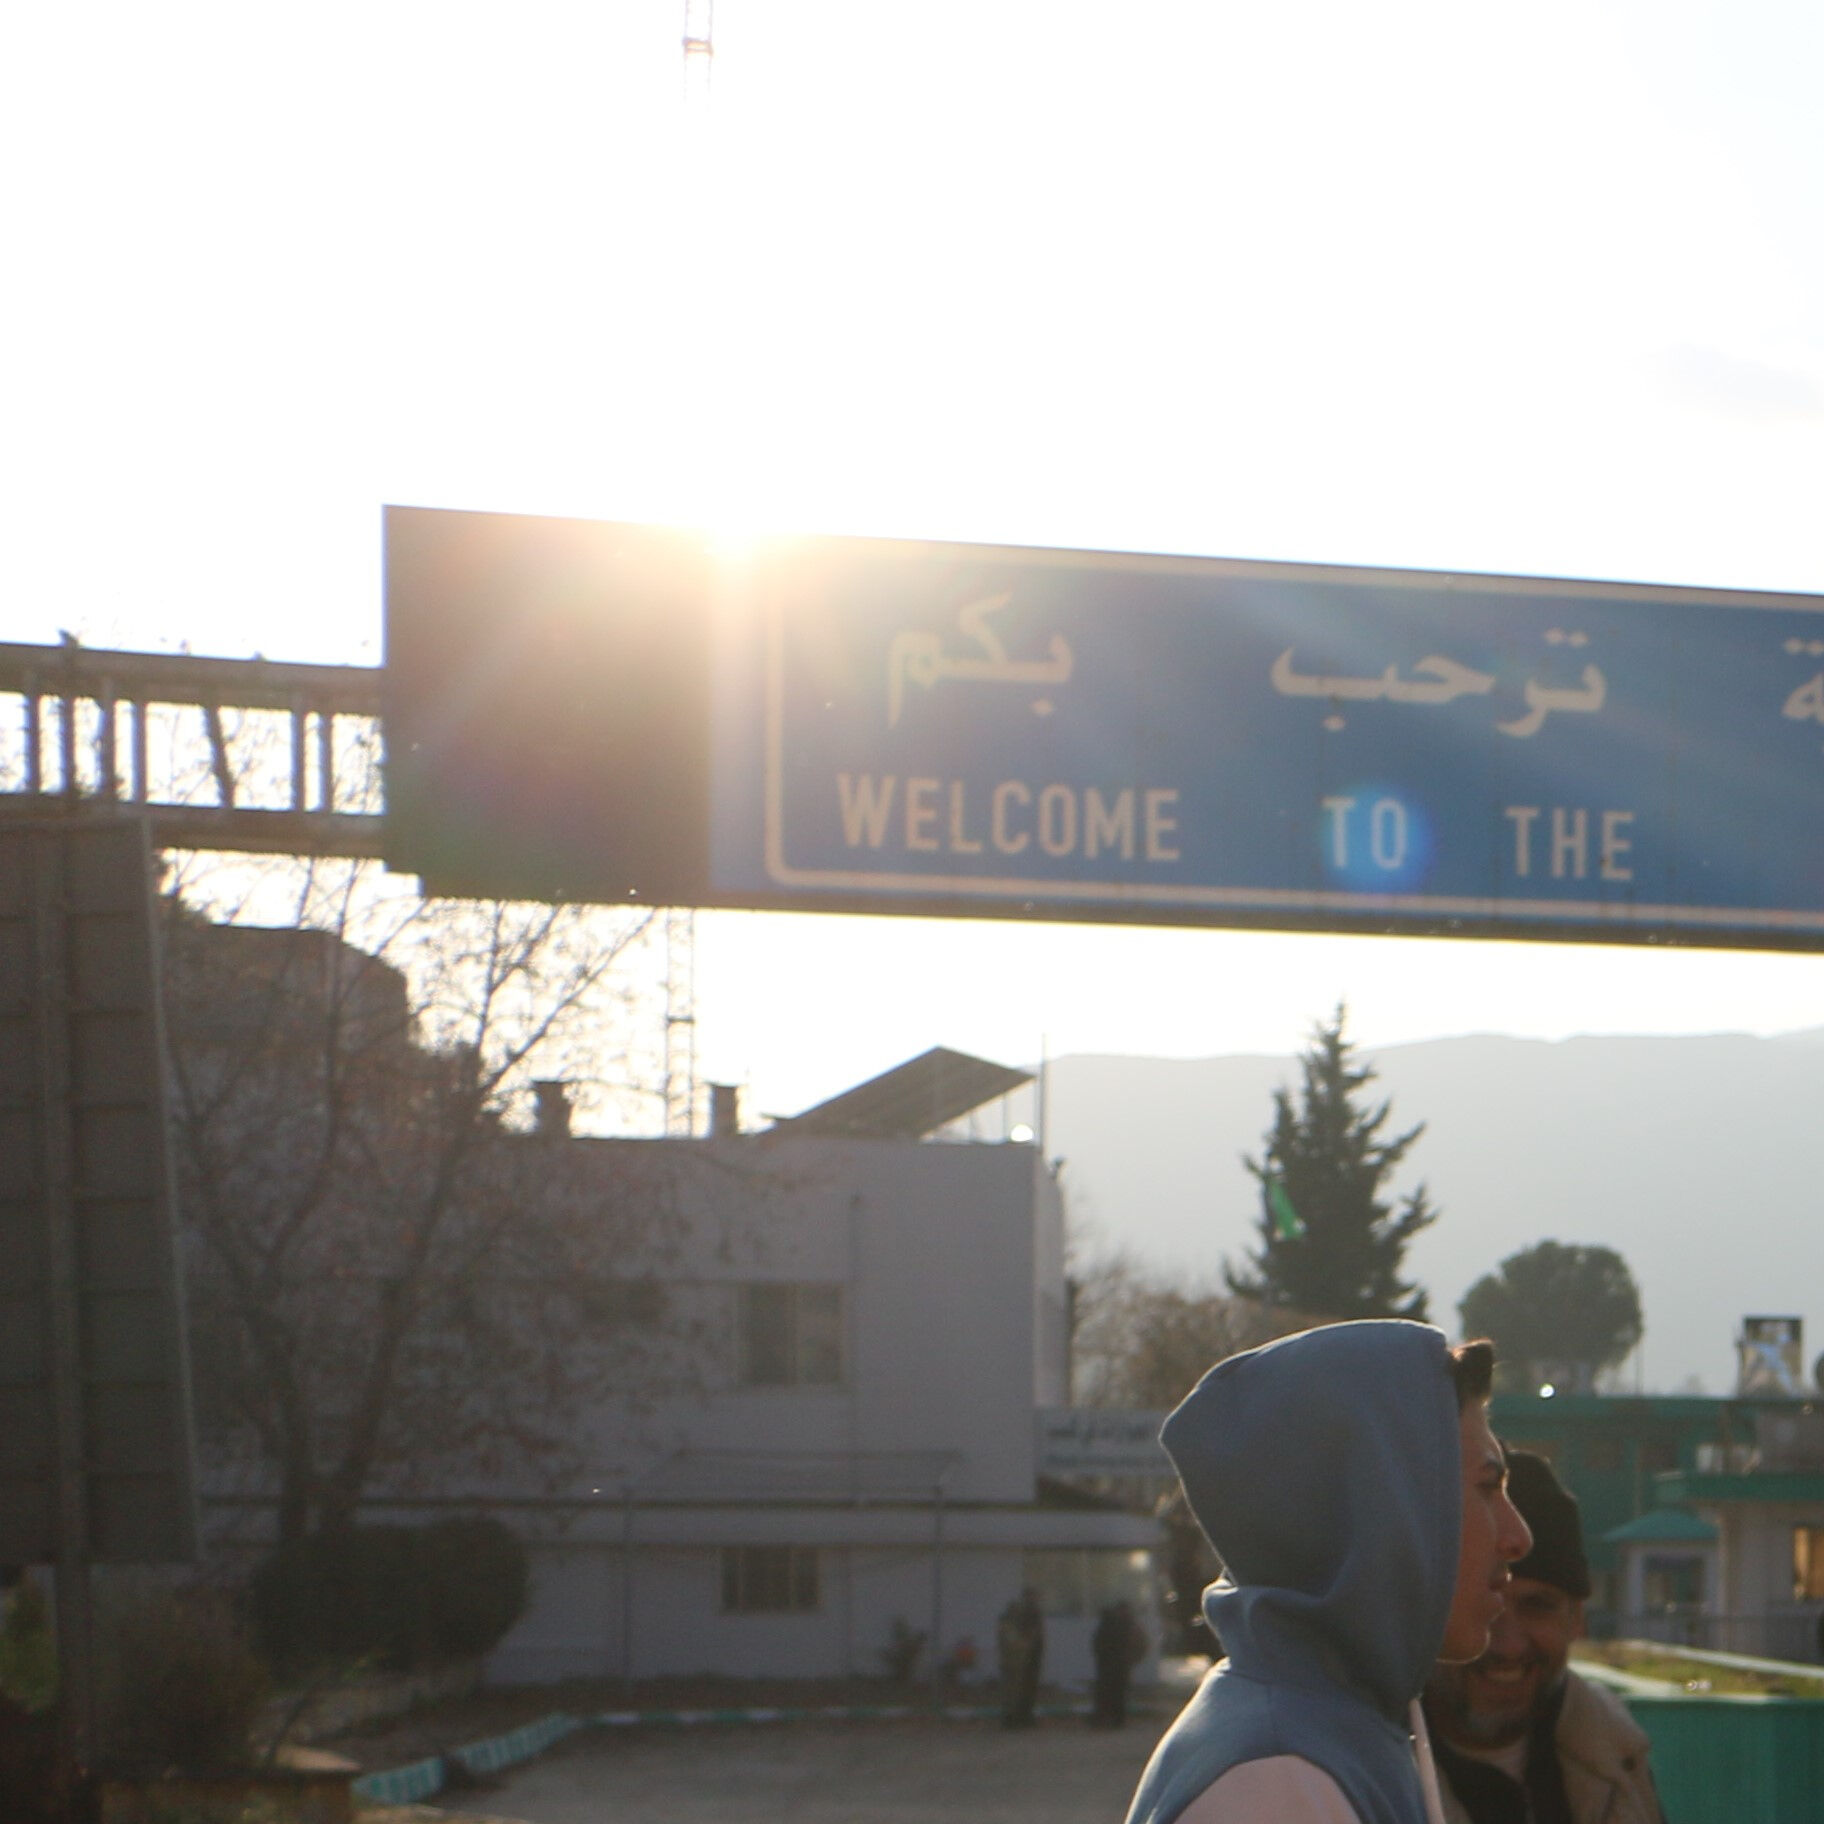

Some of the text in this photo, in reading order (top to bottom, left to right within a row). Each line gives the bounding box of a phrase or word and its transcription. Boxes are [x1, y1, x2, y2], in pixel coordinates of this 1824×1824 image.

[886, 592, 1076, 727] بكم
[1269, 629, 1606, 738] ترحب
[840, 772, 1182, 862] WELCOME
[1322, 796, 1409, 873] TO
[1504, 805, 1637, 882] THE
